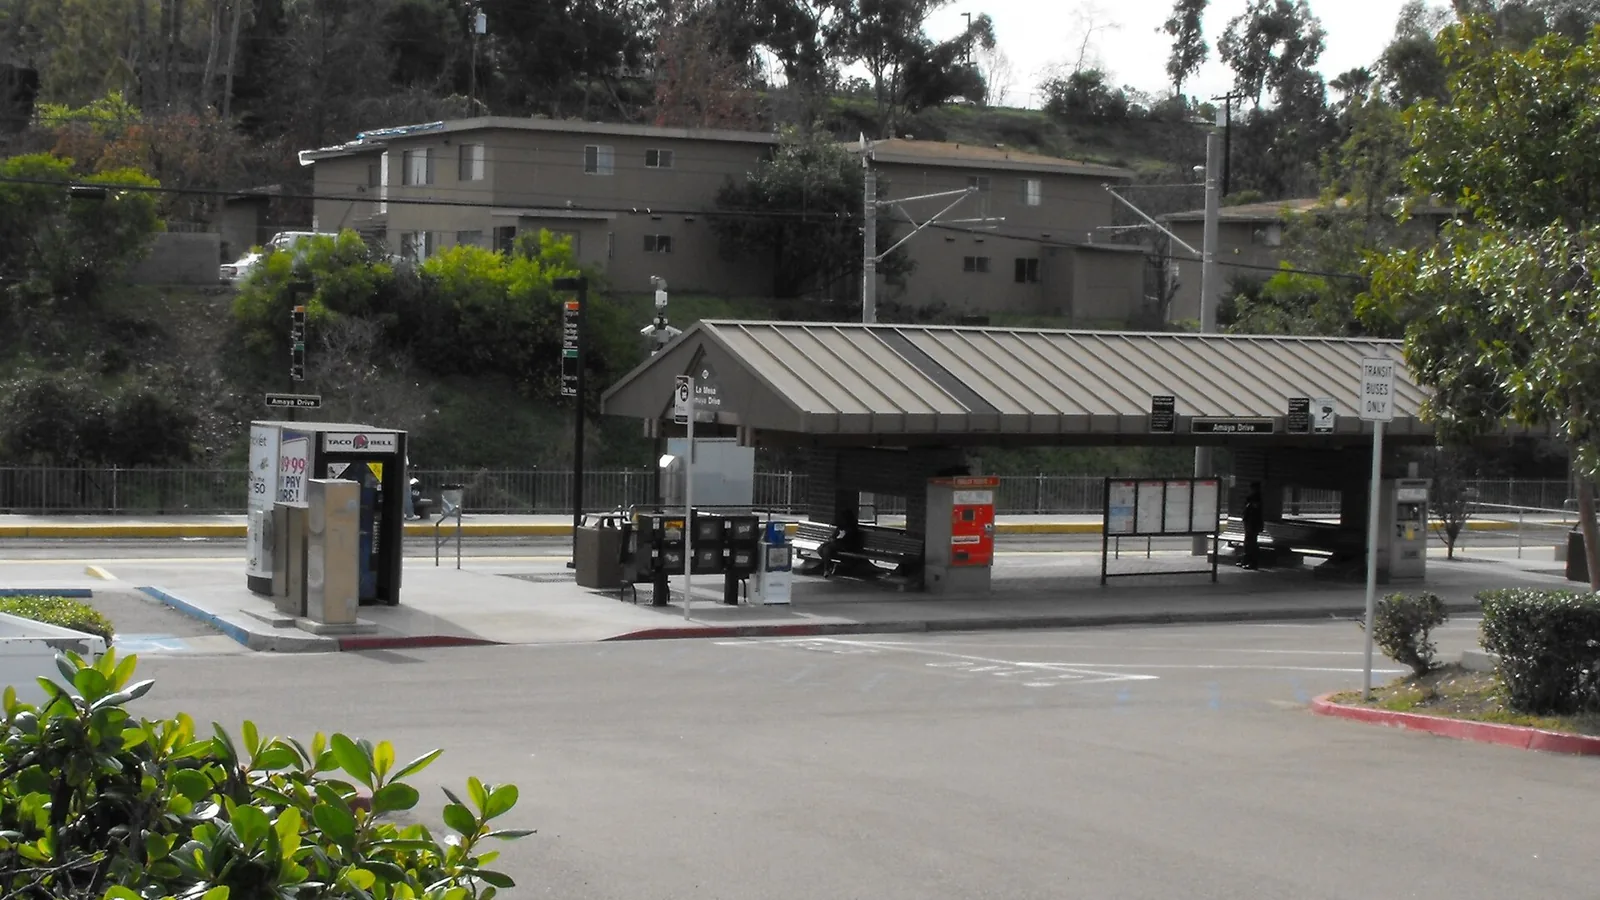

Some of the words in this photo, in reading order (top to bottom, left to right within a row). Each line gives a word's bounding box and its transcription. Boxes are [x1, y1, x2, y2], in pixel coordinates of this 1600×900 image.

[1364, 365, 1392, 377] TRANSIT
[703, 386, 716, 395] Mesa
[1366, 382, 1389, 395] BUSES
[271, 398, 295, 406] Amaya
[1366, 400, 1386, 413] ONLY
[1213, 423, 1236, 433] Amaya
[1237, 423, 1255, 432] Drive
[285, 475, 301, 489] PAY
